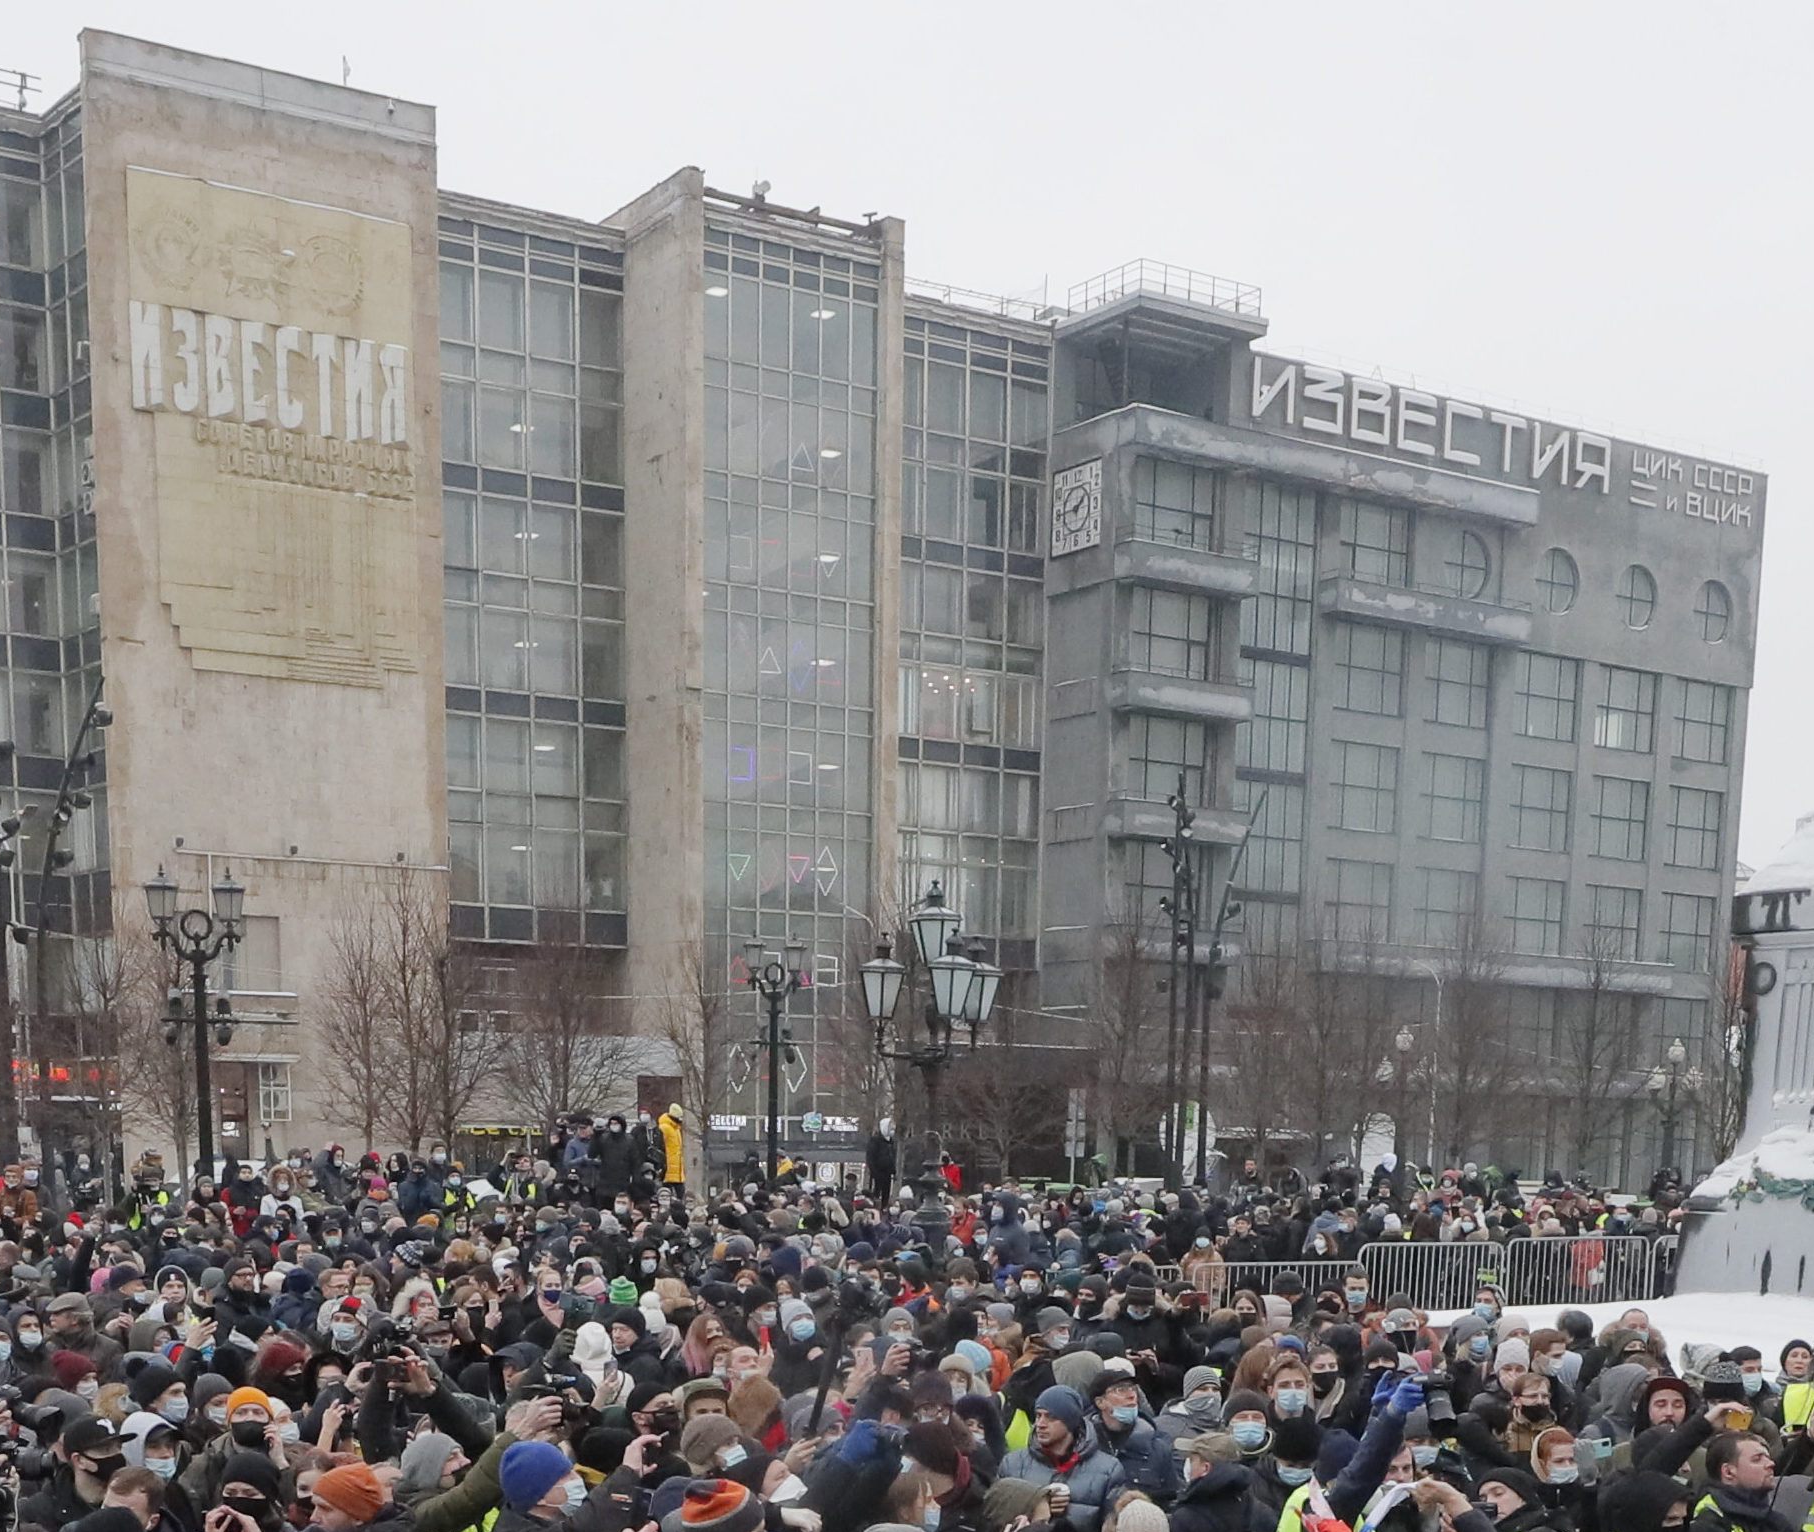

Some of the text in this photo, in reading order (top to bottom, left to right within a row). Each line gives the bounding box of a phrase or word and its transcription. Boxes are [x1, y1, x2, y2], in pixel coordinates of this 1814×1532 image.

[129, 300, 407, 446] ИЗВЕСТИЯ
[1251, 356, 1611, 494] ИЗВЕСТИЯ
[1632, 450, 1754, 496] ЦИК СССР
[1093, 496, 1098, 510] 3
[1686, 491, 1752, 527] ВЦИК
[1055, 530, 1061, 543] 8
[1073, 534, 1079, 547] 6
[1086, 530, 1091, 543] 5
